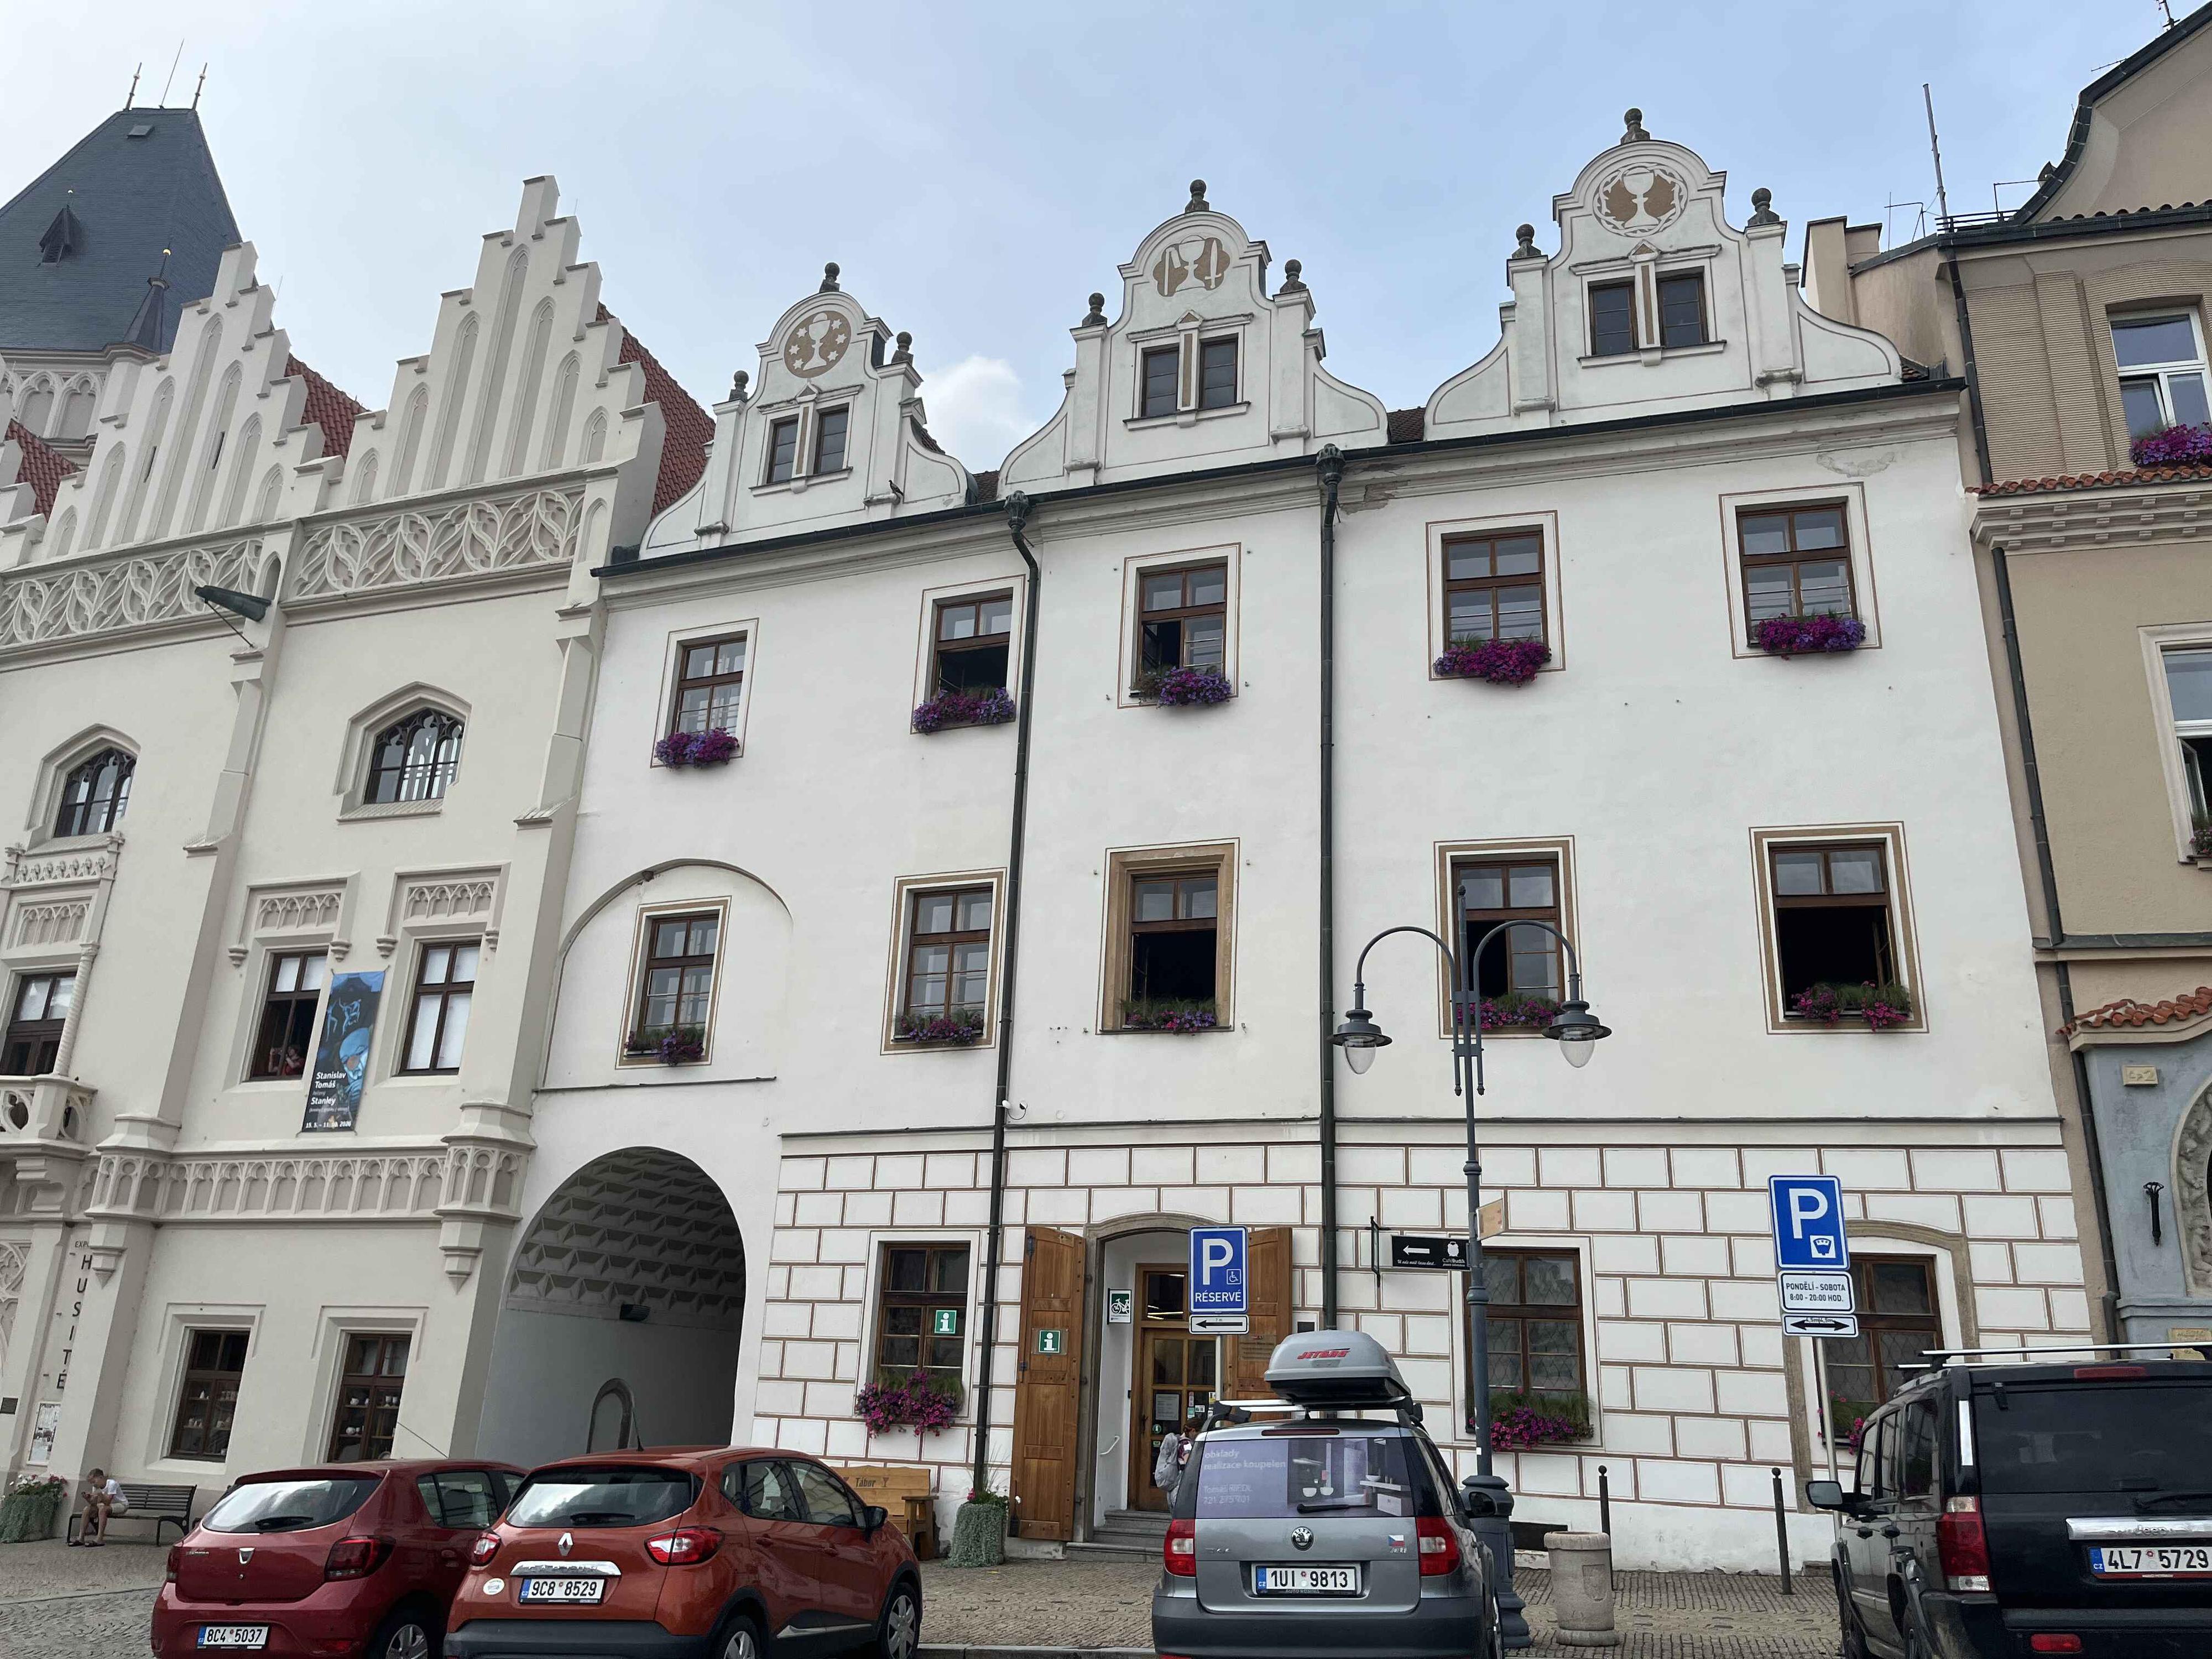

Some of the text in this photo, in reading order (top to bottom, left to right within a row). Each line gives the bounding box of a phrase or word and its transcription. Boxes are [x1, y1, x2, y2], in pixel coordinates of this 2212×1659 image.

[316, 1071, 346, 1079] Stanislav
[315, 1080, 336, 1088] Tomáš
[311, 1096, 336, 1106] Stanley
[1789, 1188, 1828, 1239] P
[1203, 1239, 1233, 1285] P
[1786, 1281, 1814, 1291] PONDĚLÍ
[1195, 1289, 1241, 1302] RÉSERVÉ
[1204, 1449, 1239, 1458] obklady
[1204, 1460, 1286, 1470] realizace koupelen
[855, 1477, 876, 1488] Tábor
[2133, 1525, 2166, 1535] Jeep
[2108, 1550, 2141, 1569] 4L7
[2158, 1549, 2209, 1569] 5729
[1310, 1571, 1348, 1588] 9813
[531, 1581, 597, 1597] 9C8 8529
[207, 1629, 262, 1642] 8C4 5037
